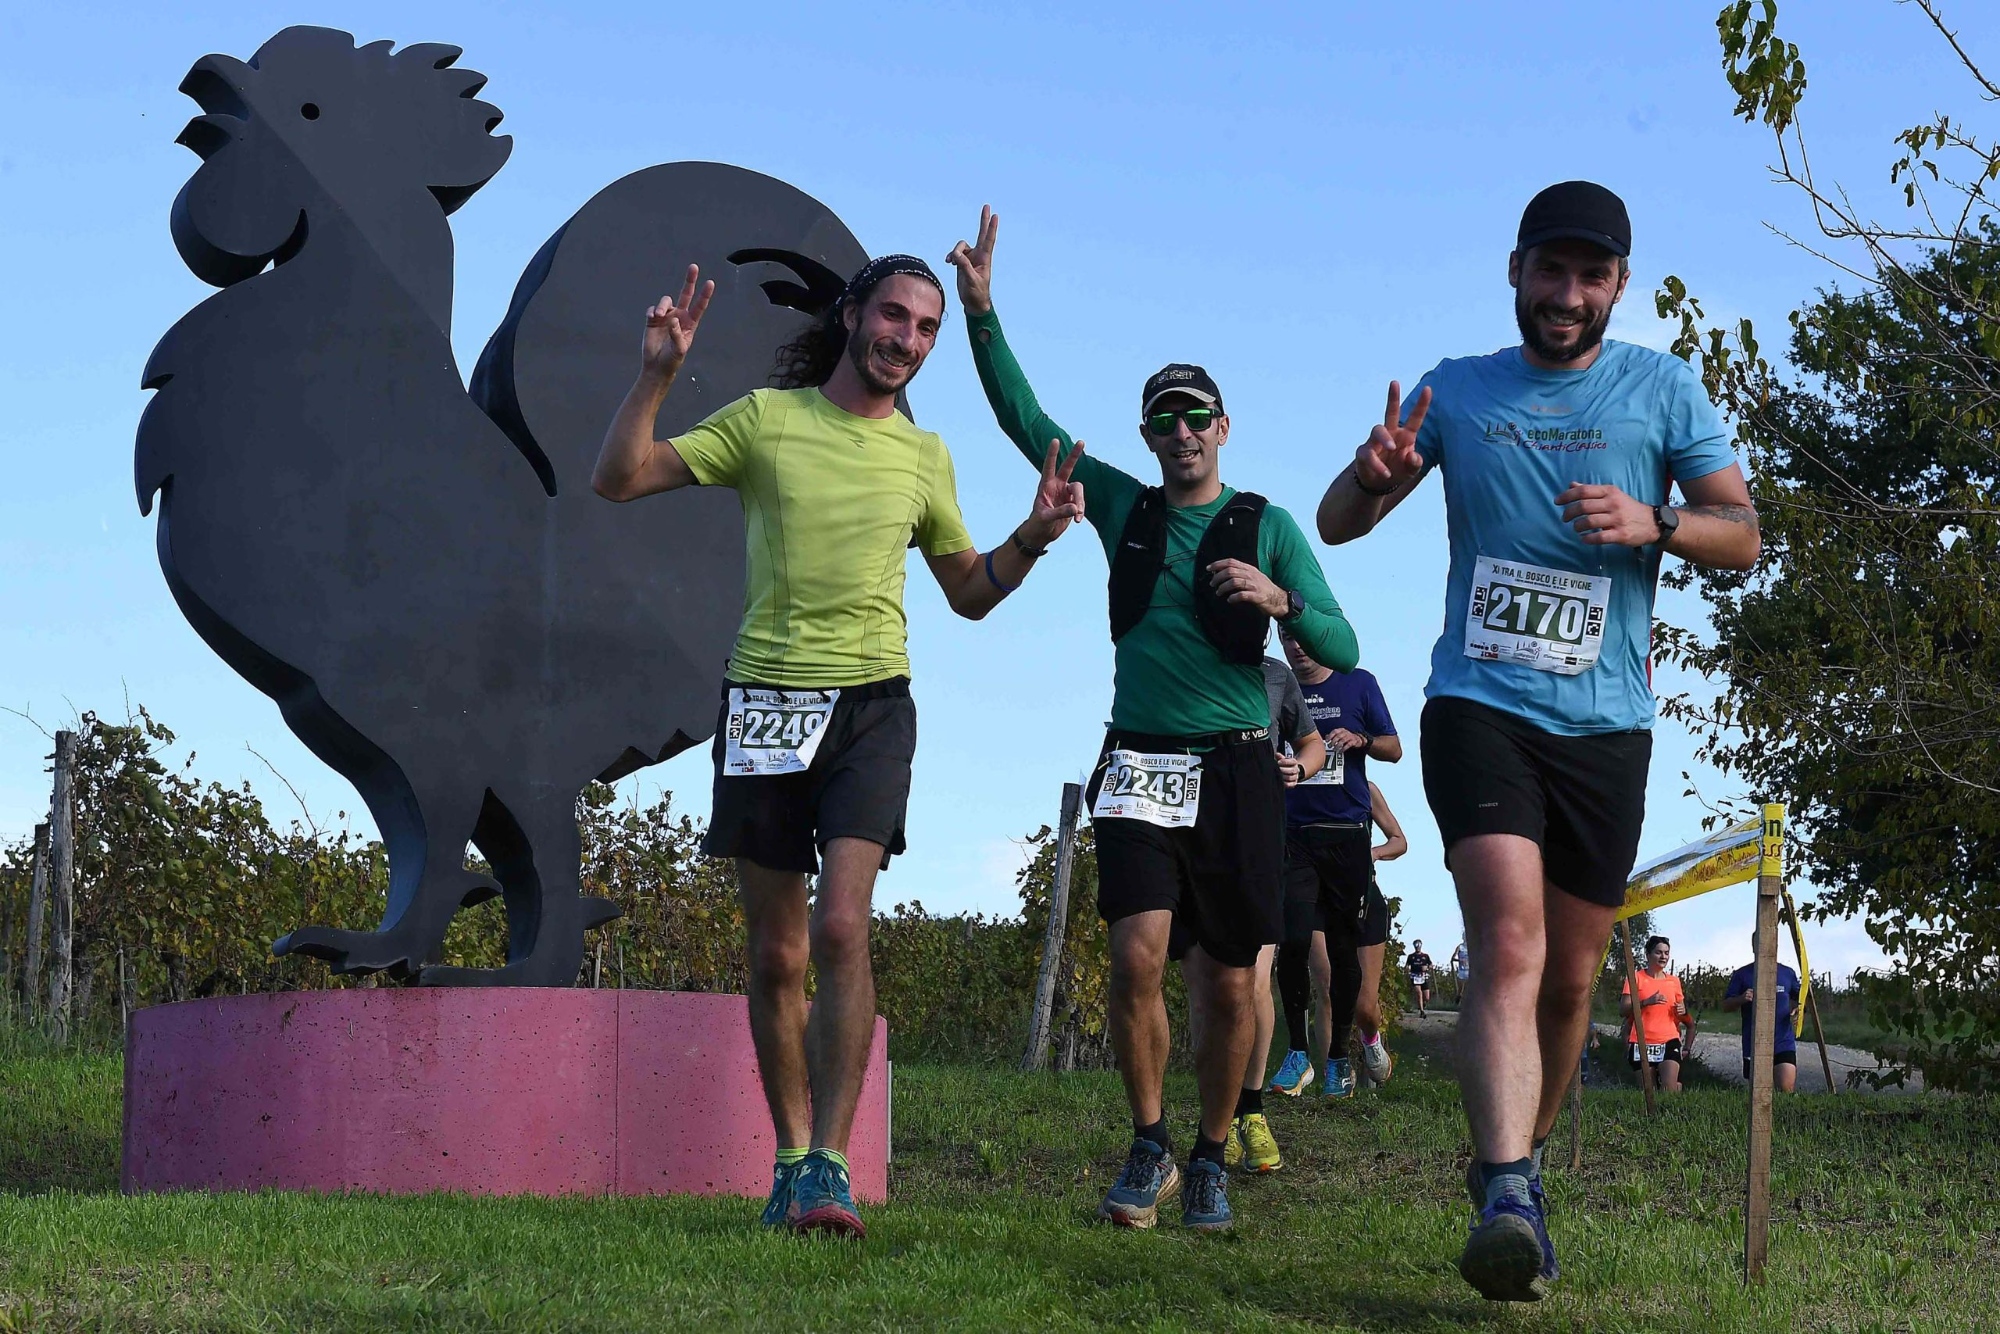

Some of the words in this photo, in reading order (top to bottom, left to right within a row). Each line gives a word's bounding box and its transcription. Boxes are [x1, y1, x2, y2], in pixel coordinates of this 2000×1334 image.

[1527, 428, 1602, 442] ecoMaratona
[1501, 567, 1515, 577] TRA
[1516, 570, 1523, 579] IL
[1525, 571, 1551, 584] BOSCO
[1552, 576, 1558, 585] E
[1558, 577, 1568, 586] LE
[1570, 580, 1593, 591] VIGNE
[1486, 586, 1584, 641] 2170
[742, 710, 823, 746] 2249
[1114, 766, 1184, 805] 2243
